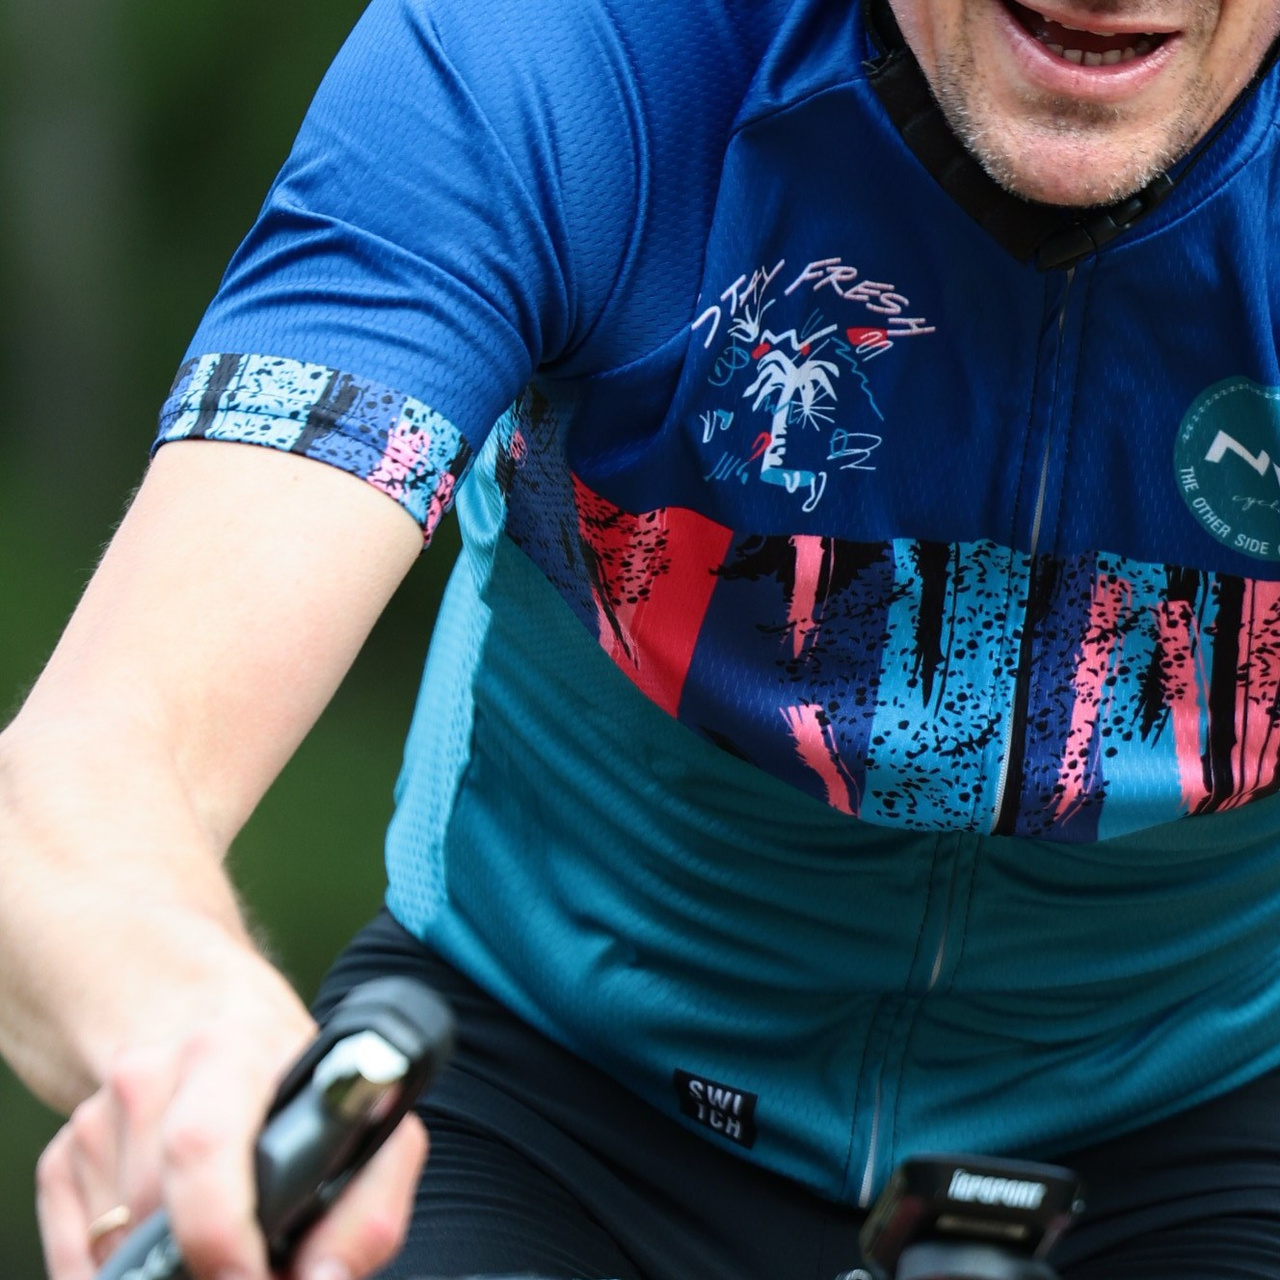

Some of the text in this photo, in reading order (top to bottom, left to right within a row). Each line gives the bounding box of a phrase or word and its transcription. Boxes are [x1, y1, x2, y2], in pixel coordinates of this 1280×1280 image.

[784, 257, 937, 337] FRESH
[1180, 466, 1200, 493] THE
[1192, 496, 1232, 538] OTHER
[1235, 533, 1269, 555] SIDE
[688, 1079, 742, 1116] SWI
